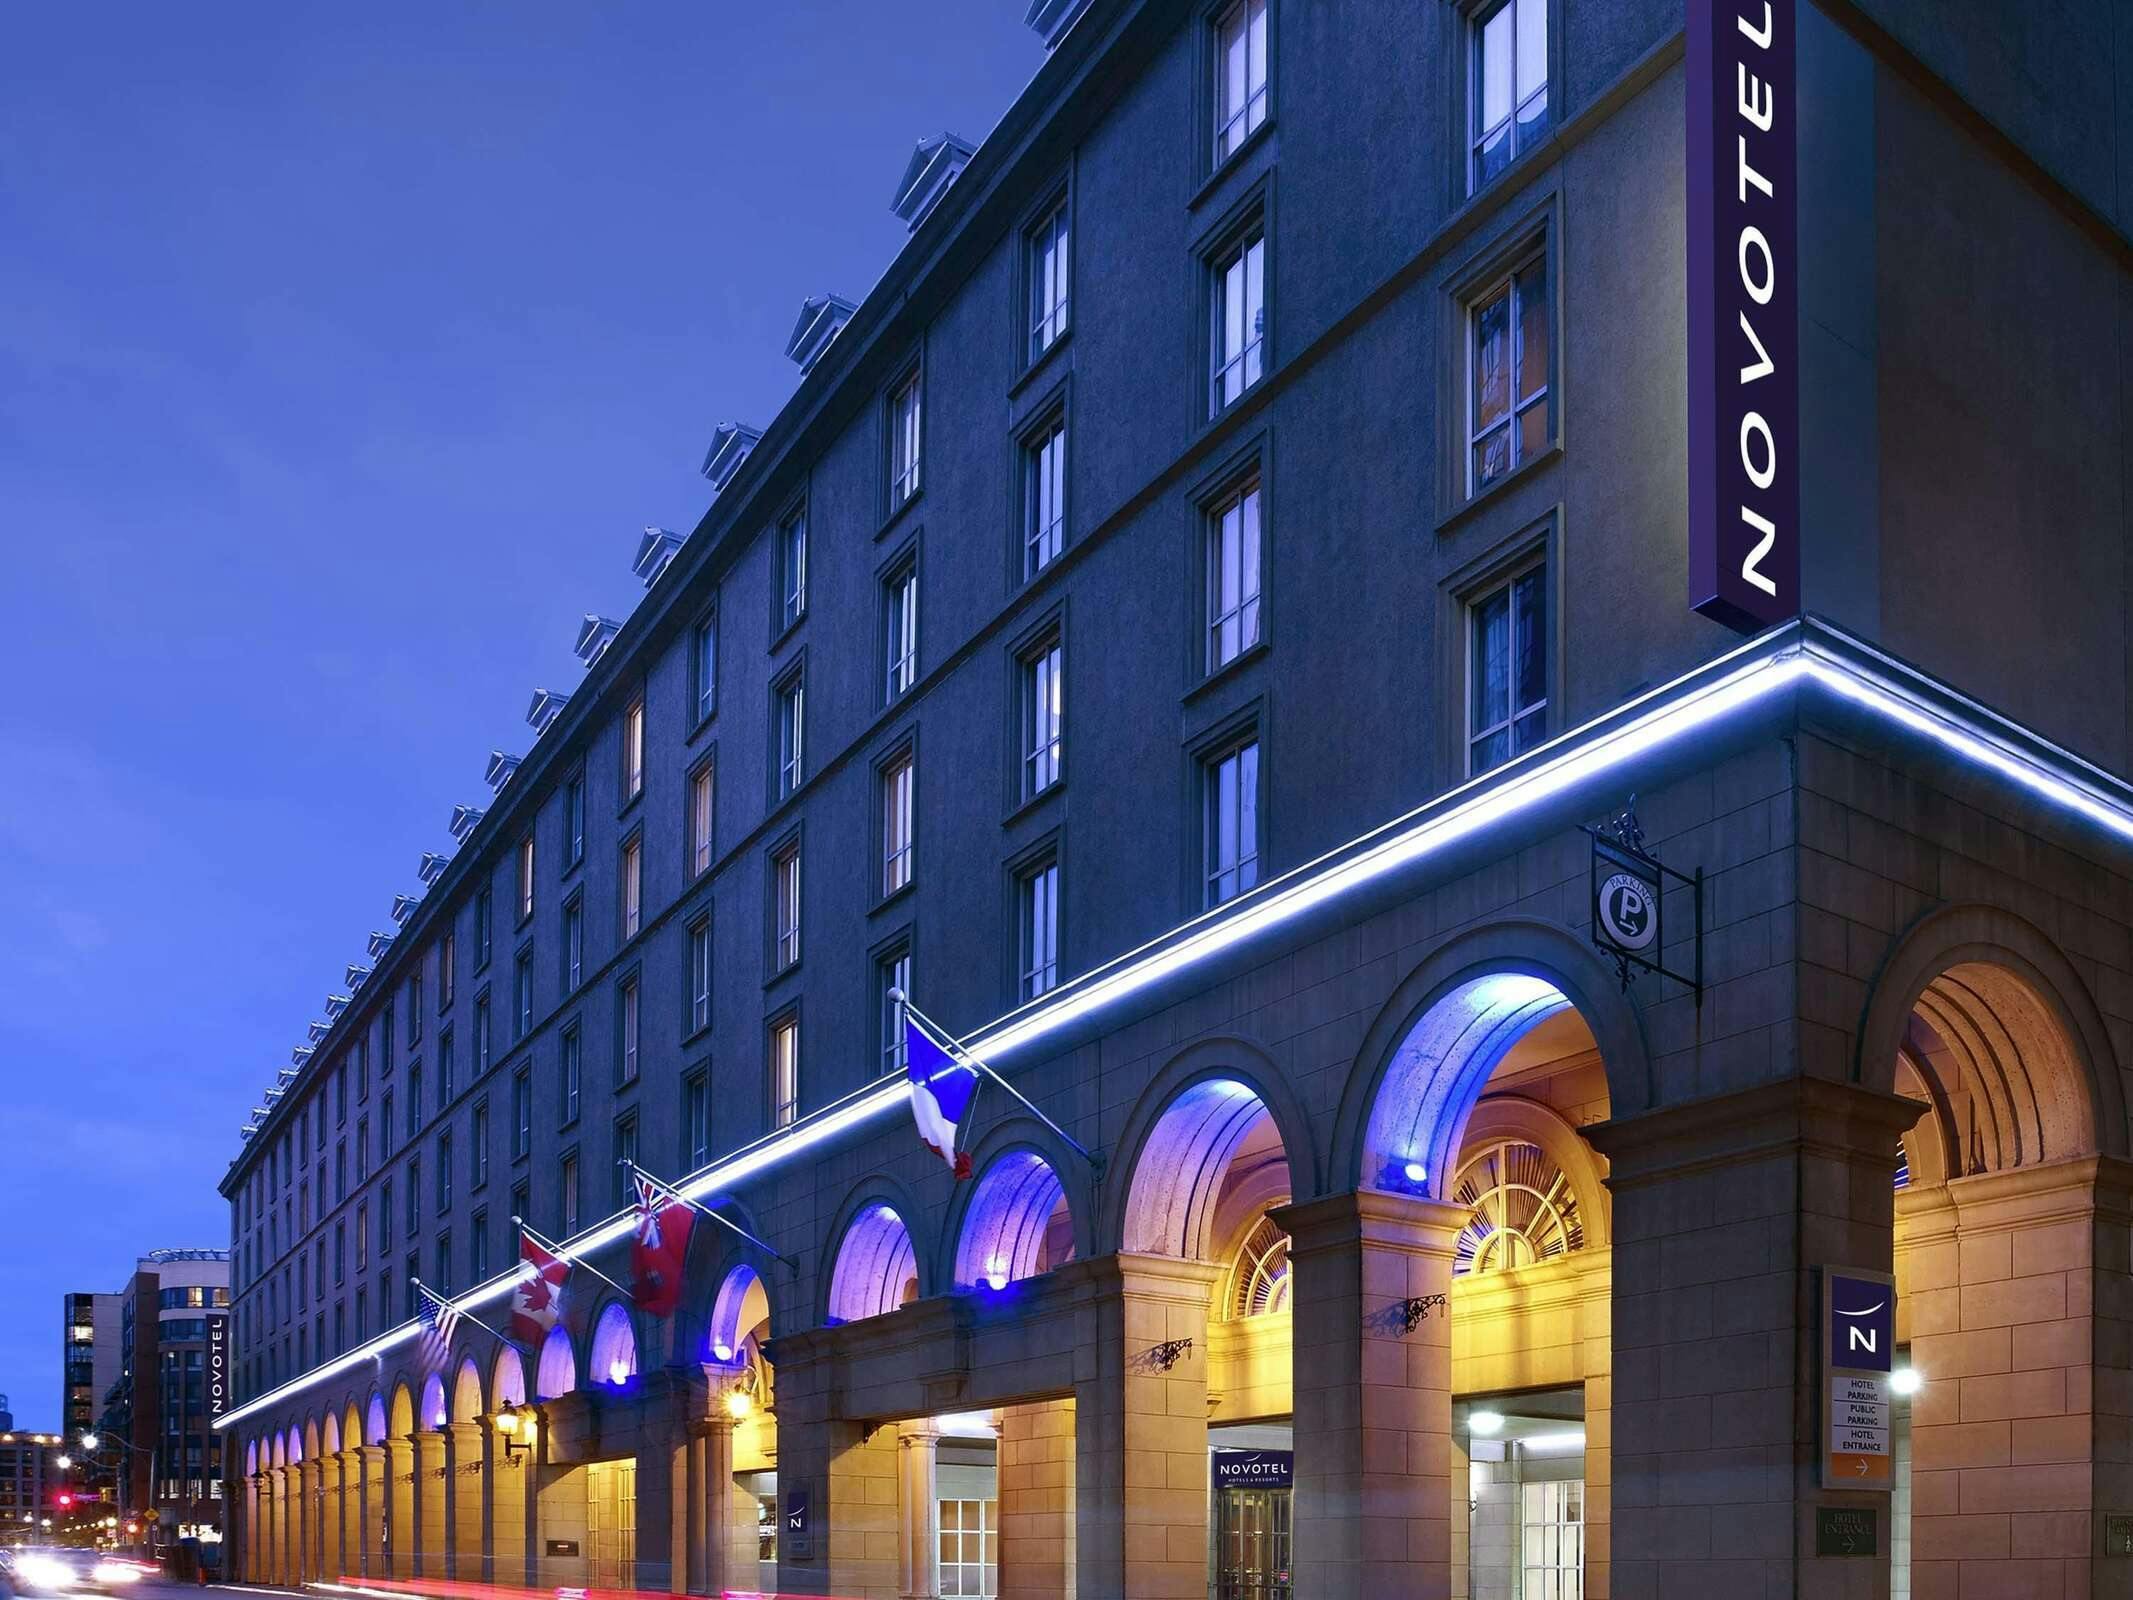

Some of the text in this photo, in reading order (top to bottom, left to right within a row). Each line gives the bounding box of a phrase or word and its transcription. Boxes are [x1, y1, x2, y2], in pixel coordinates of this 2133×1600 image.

[1737, 1, 1776, 597] NOVOTEL
[1609, 875, 1655, 907] PARKING
[1620, 888, 1642, 920] P
[1850, 1325, 1876, 1353] N
[212, 1319, 222, 1413] NOVOTEL
[1851, 1380, 1875, 1390] HOTEL
[1847, 1391, 1878, 1401] PARKING
[1850, 1404, 1876, 1414] PUBLIC
[1847, 1416, 1878, 1426] PARKING
[1851, 1430, 1875, 1440] HOTEL
[1842, 1441, 1881, 1452] ENTRANCE
[1220, 1463, 1288, 1475] NOVOTEL
[790, 1518, 801, 1528] N
